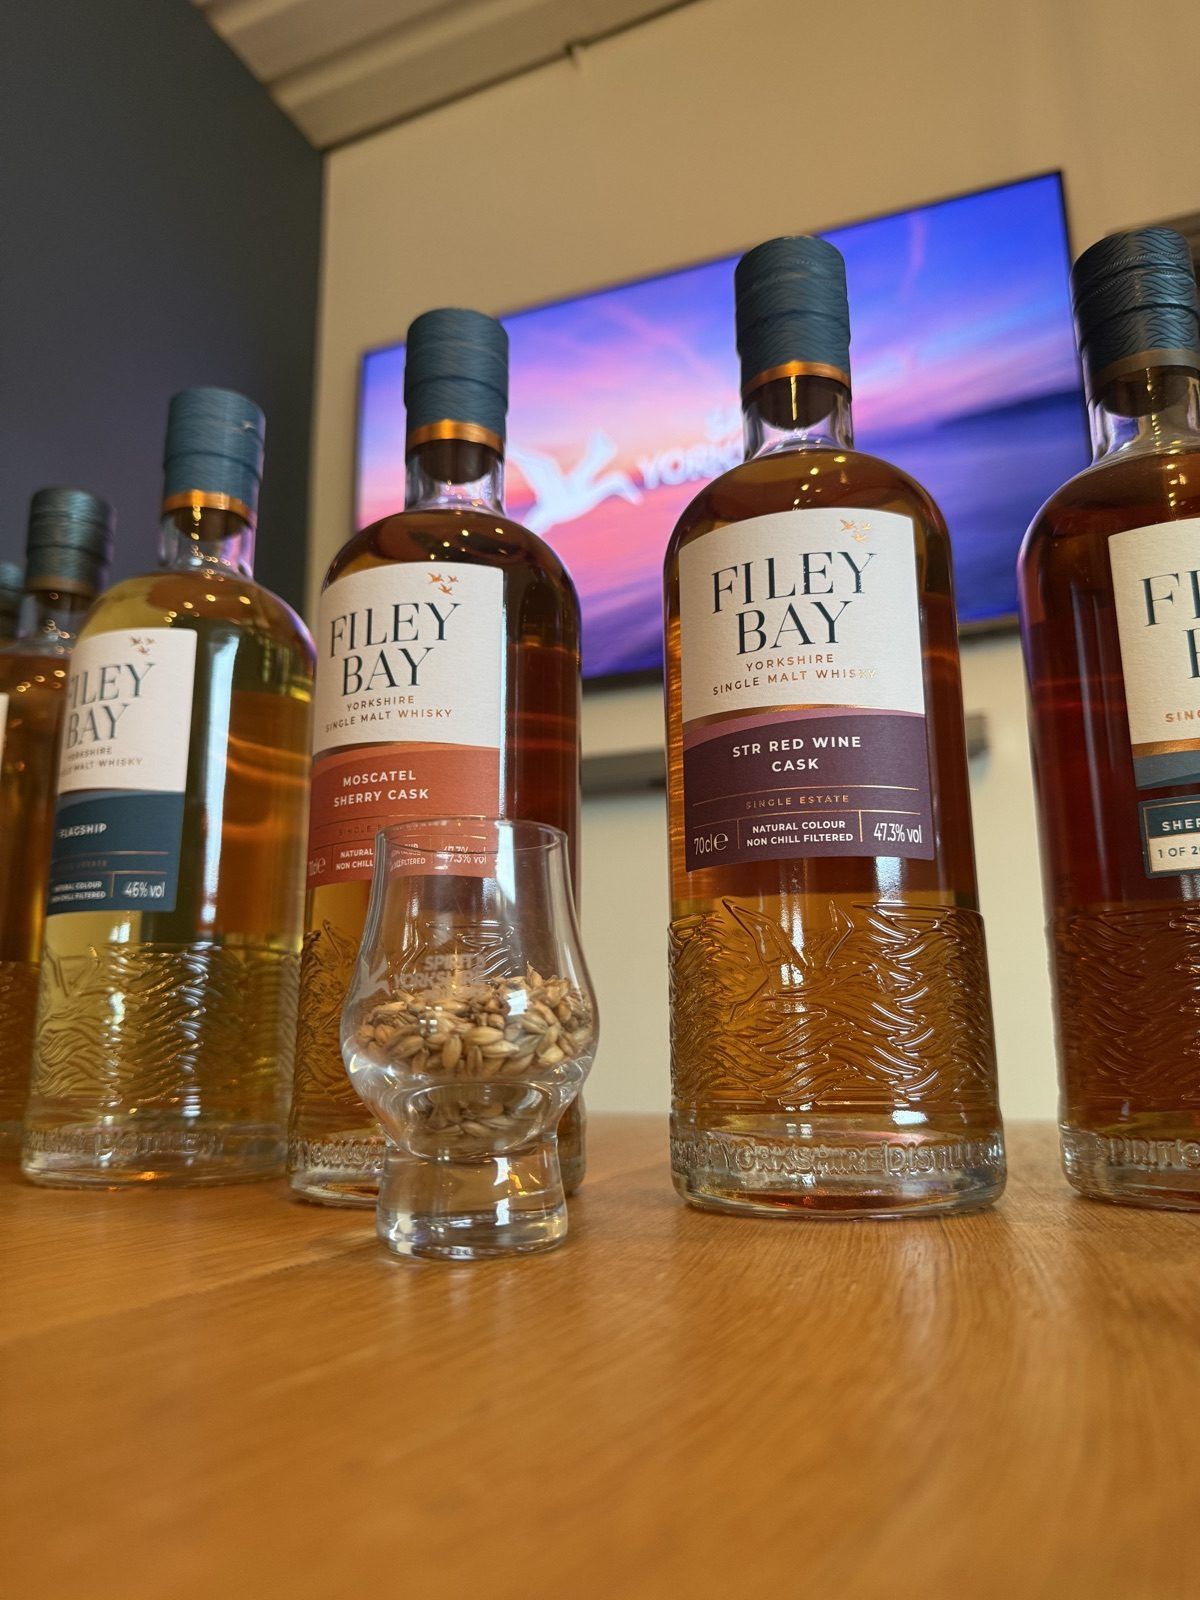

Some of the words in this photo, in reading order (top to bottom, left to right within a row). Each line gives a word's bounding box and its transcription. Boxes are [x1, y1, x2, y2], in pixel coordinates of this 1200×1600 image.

[711, 551, 878, 614] FILEY
[330, 602, 462, 658] FILEY
[735, 600, 853, 656] BAY
[341, 647, 434, 696] BAY
[746, 653, 834, 672] YORKSHIRE
[69, 662, 156, 710] ILEY
[712, 677, 760, 696] SINGLE
[767, 670, 807, 685] MALT
[815, 669, 877, 680] WHISKY
[347, 695, 414, 712] YORKSHIRE
[66, 703, 130, 750] BAY
[325, 716, 356, 733] SINGLE
[360, 710, 391, 723] MALT
[397, 708, 453, 719] WHISKY
[732, 743, 761, 758] STR
[769, 738, 804, 752] RED
[812, 736, 862, 749] WINE
[100, 757, 143, 768] WHISKY
[771, 757, 820, 773] CASK
[343, 770, 417, 787] MOSCATEL
[333, 790, 382, 808] SHERRY
[387, 788, 430, 801] CASK
[746, 796, 792, 810] SINGLE
[799, 794, 850, 805] ESTATE
[60, 822, 107, 839] FLAGSHIP
[752, 821, 799, 834] NATURAL
[801, 820, 846, 830] COLOUR
[873, 823, 906, 842] 47.3%
[906, 824, 923, 844] vol
[746, 836, 768, 847] NON
[770, 834, 800, 845] CHILL
[803, 832, 854, 843] FILTERED
[340, 848, 374, 858] NATURAL
[1158, 849, 1164, 859] 1
[1168, 847, 1186, 857] OF
[1191, 846, 1200, 856] 2
[335, 862, 350, 871] NON
[352, 860, 374, 869] CHILL
[123, 881, 148, 898] 46%
[150, 881, 166, 898] vol
